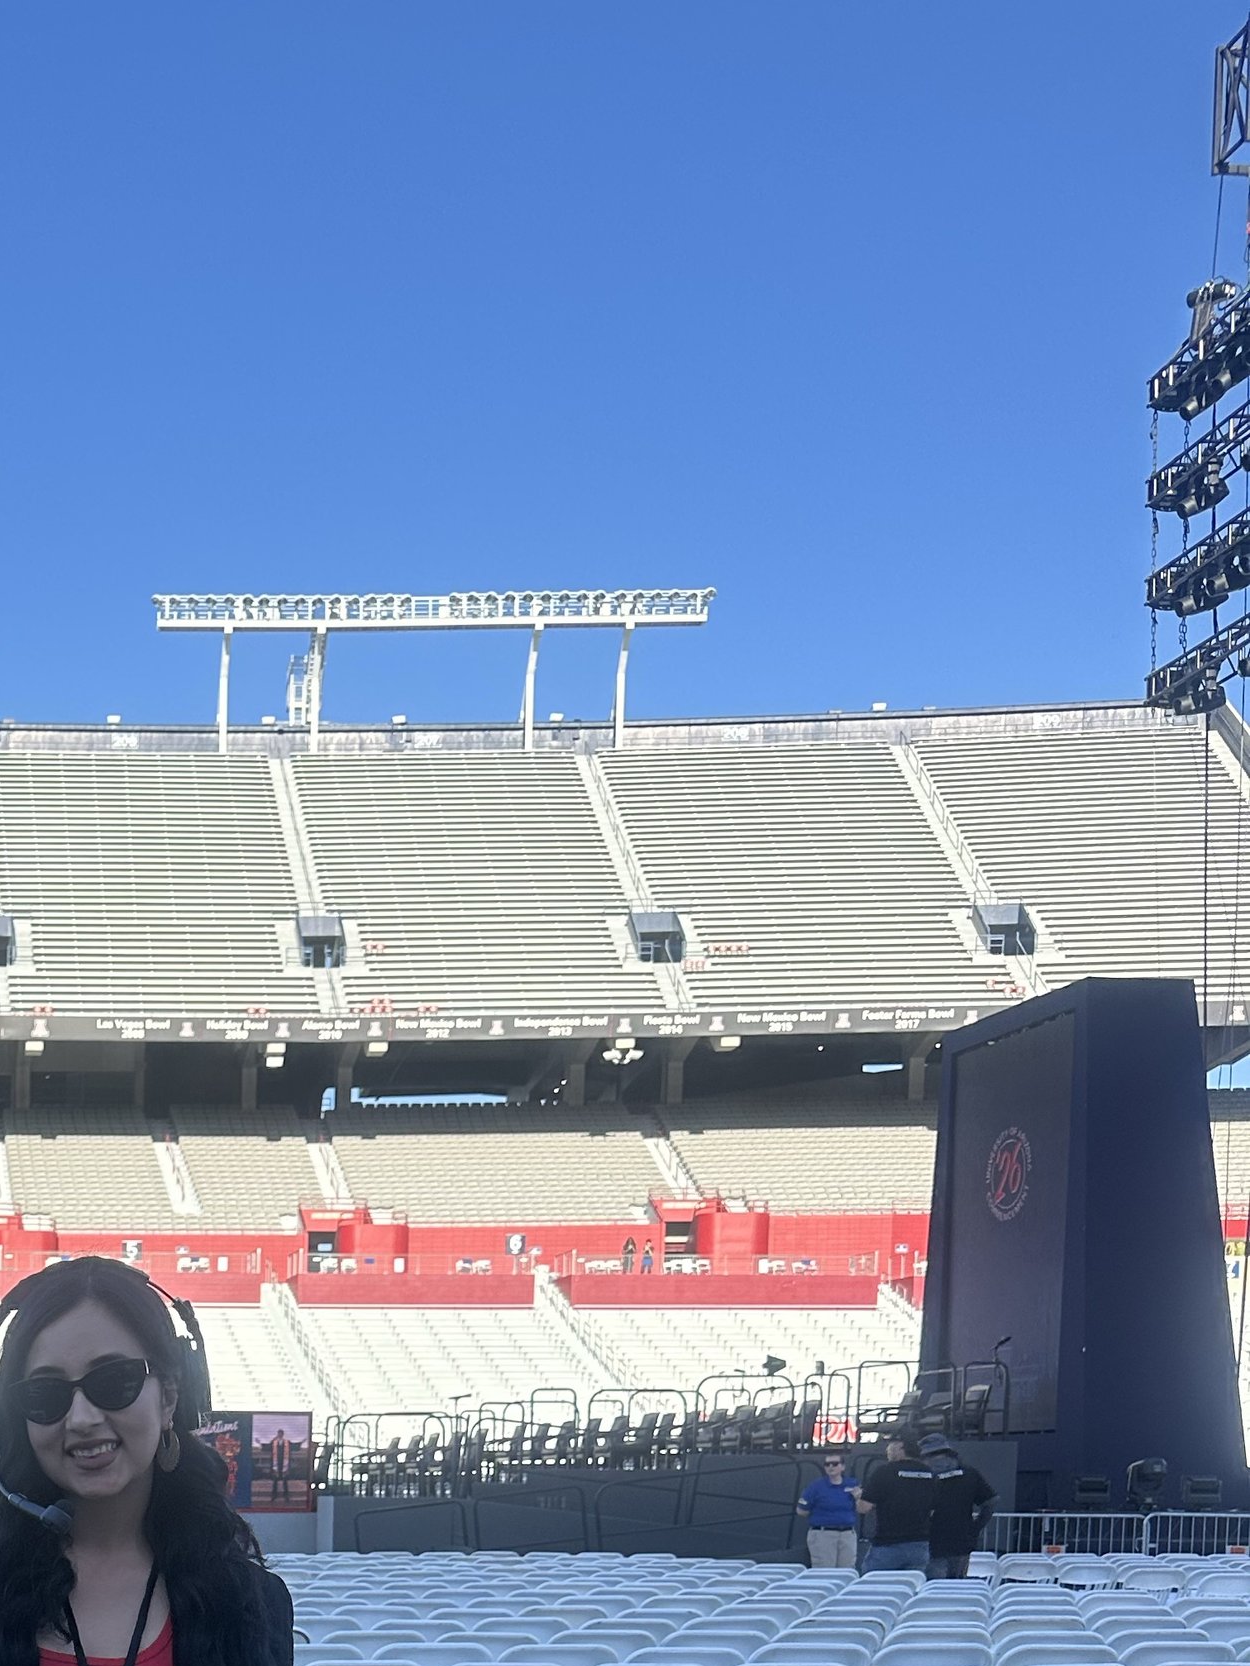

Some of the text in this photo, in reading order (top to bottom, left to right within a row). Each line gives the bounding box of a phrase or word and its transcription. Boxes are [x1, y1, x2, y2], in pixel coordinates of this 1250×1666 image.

[674, 1014, 700, 1025] Bowl
[737, 1012, 761, 1023] New
[800, 1011, 826, 1022] Bowl
[862, 1008, 954, 1021] Foster Farms Bowl
[97, 1019, 170, 1030] Las Vegas Bowl
[243, 1019, 268, 1029] Bowl
[335, 1019, 360, 1029] Bowl
[396, 1019, 419, 1029] New
[455, 1018, 482, 1028] Bowl
[582, 1016, 608, 1026] Bowl
[509, 1233, 522, 1251] 6
[126, 1241, 139, 1258] 5
